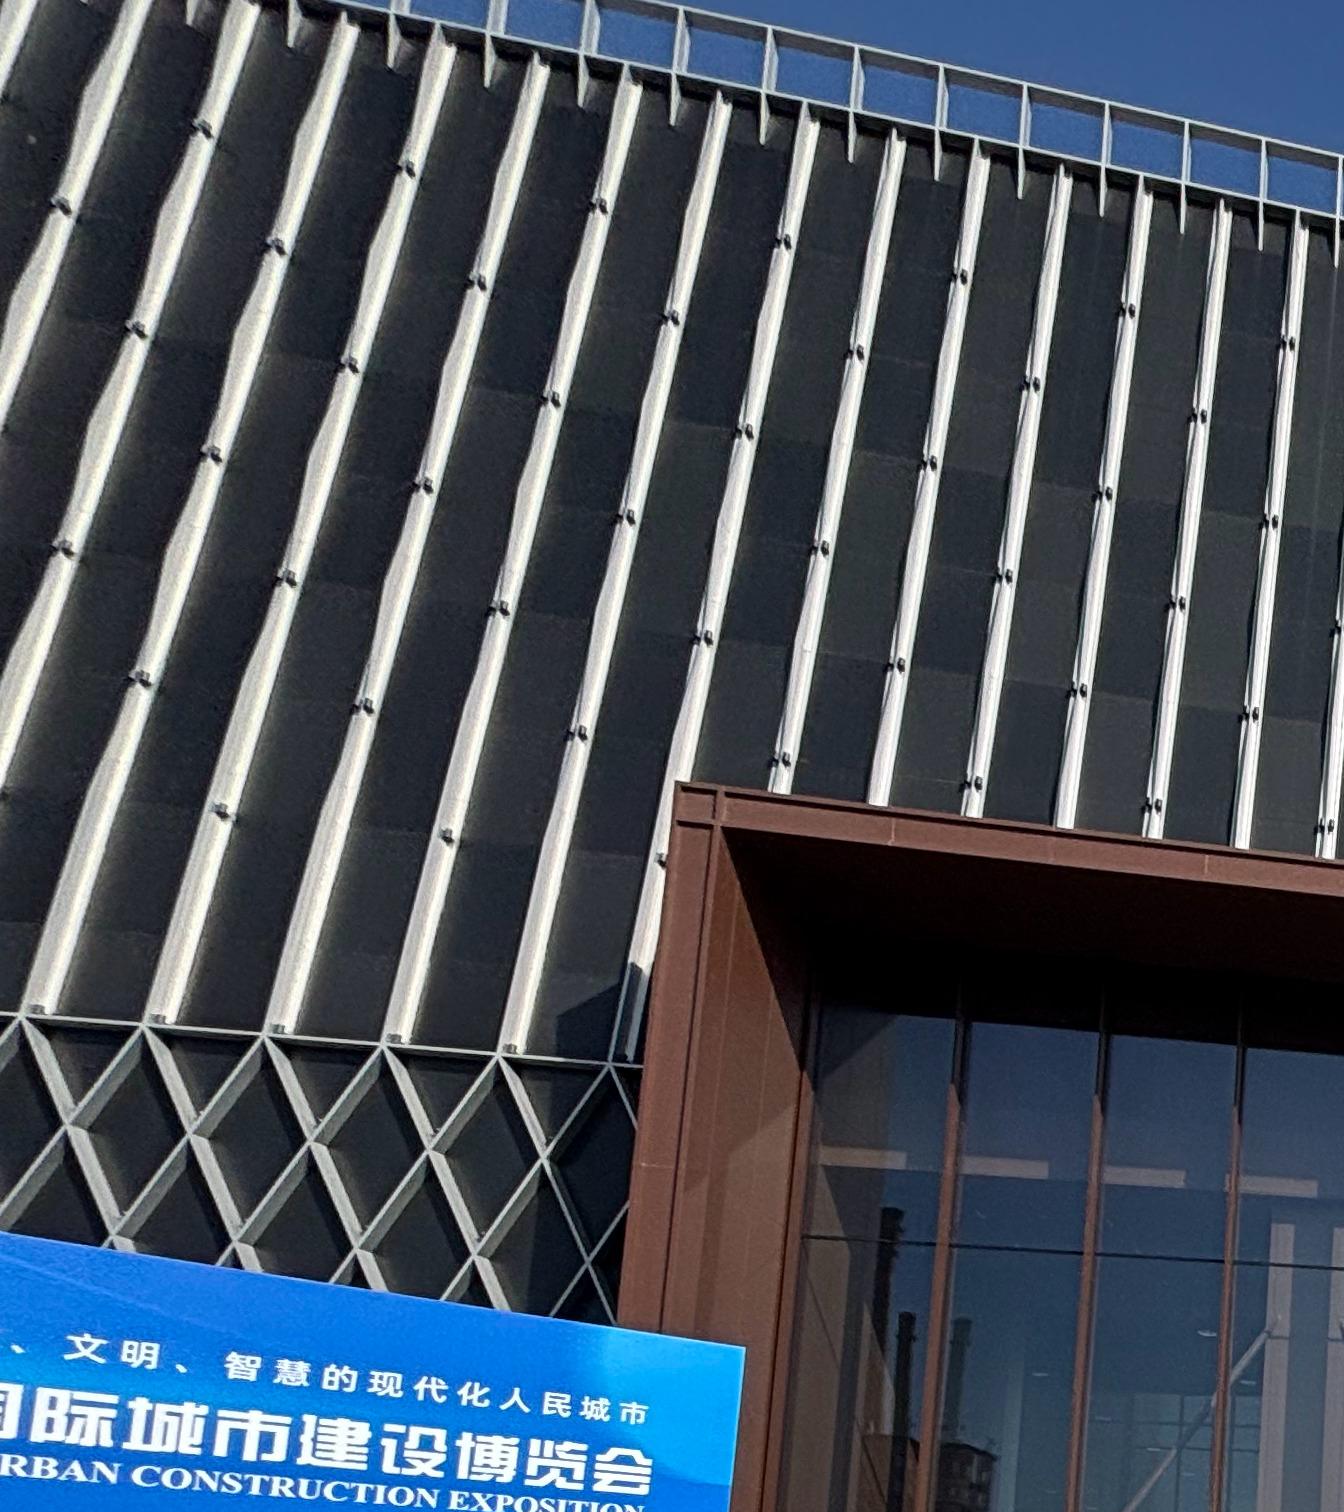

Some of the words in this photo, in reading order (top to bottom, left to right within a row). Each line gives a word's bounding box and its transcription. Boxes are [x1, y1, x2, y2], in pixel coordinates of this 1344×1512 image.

[0, 1382, 653, 1496] 际城市建设博览会
[131, 1465, 439, 1510] CONSTRUCTION
